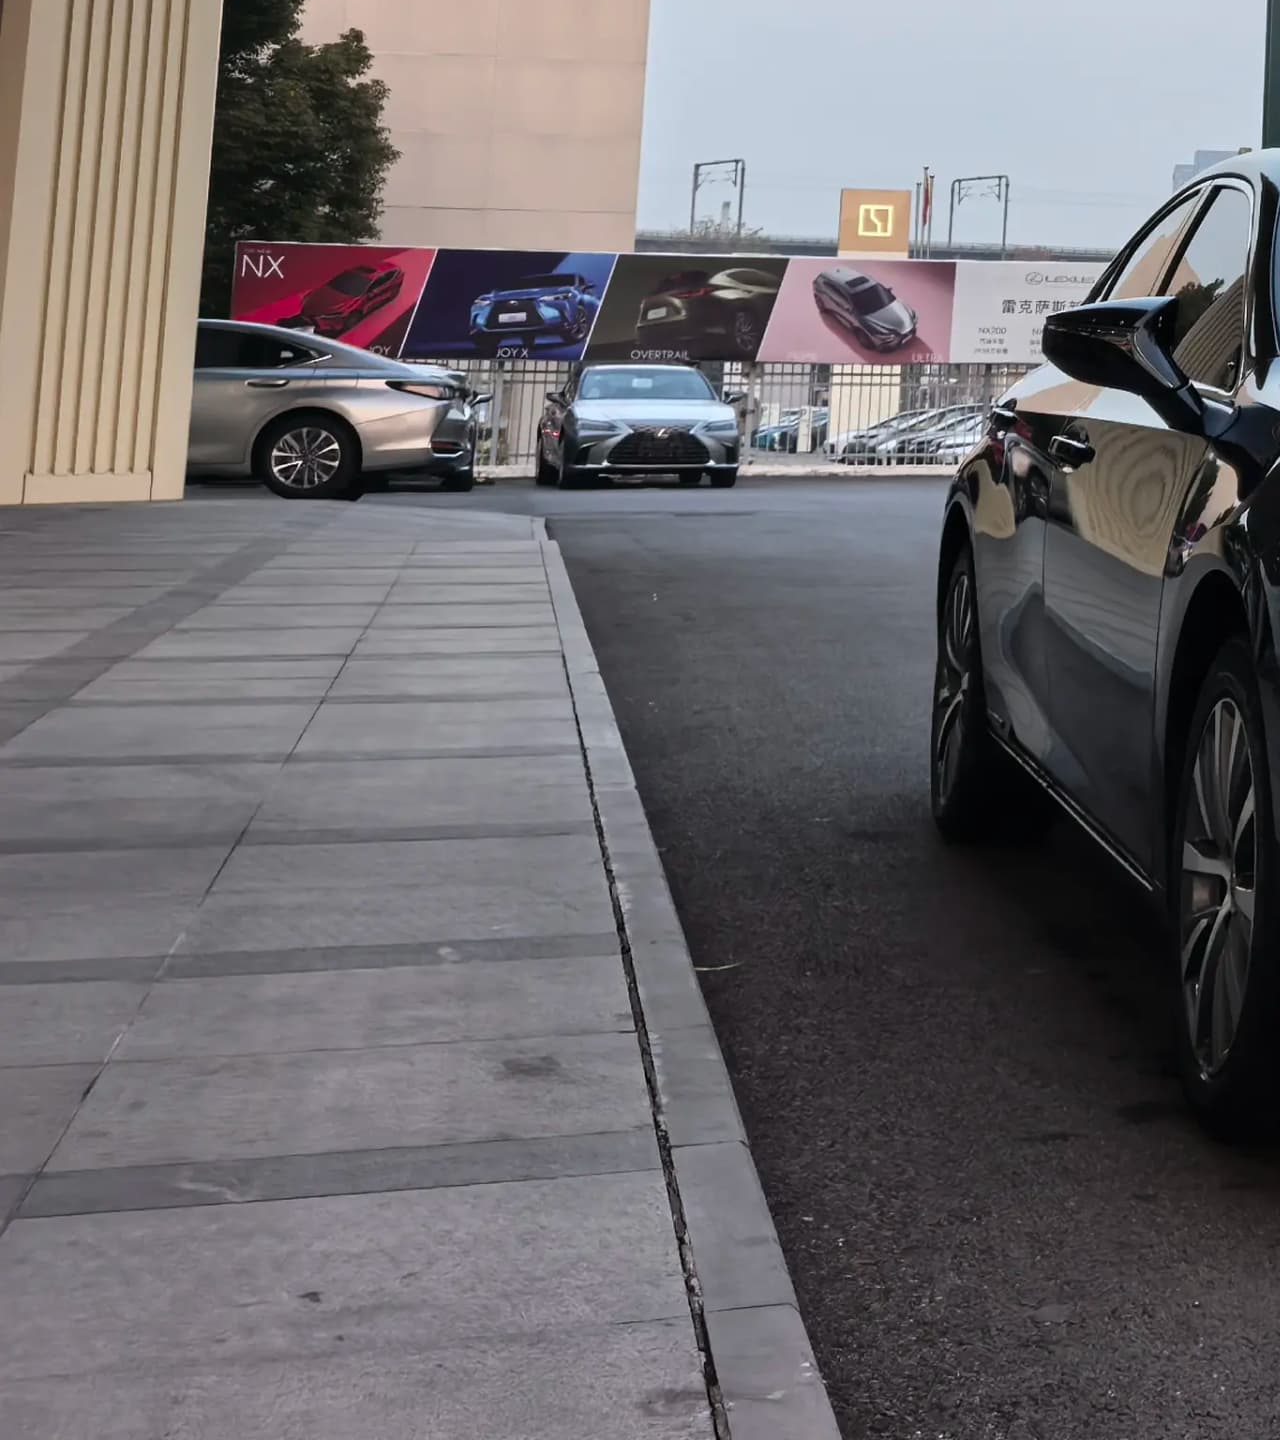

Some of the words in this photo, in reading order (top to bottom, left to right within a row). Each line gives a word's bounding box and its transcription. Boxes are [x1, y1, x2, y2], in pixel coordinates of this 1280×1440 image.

[241, 254, 286, 279] NX
[496, 347, 519, 358] JOY
[520, 347, 529, 358] X
[630, 349, 691, 361] OVERTRAIL
